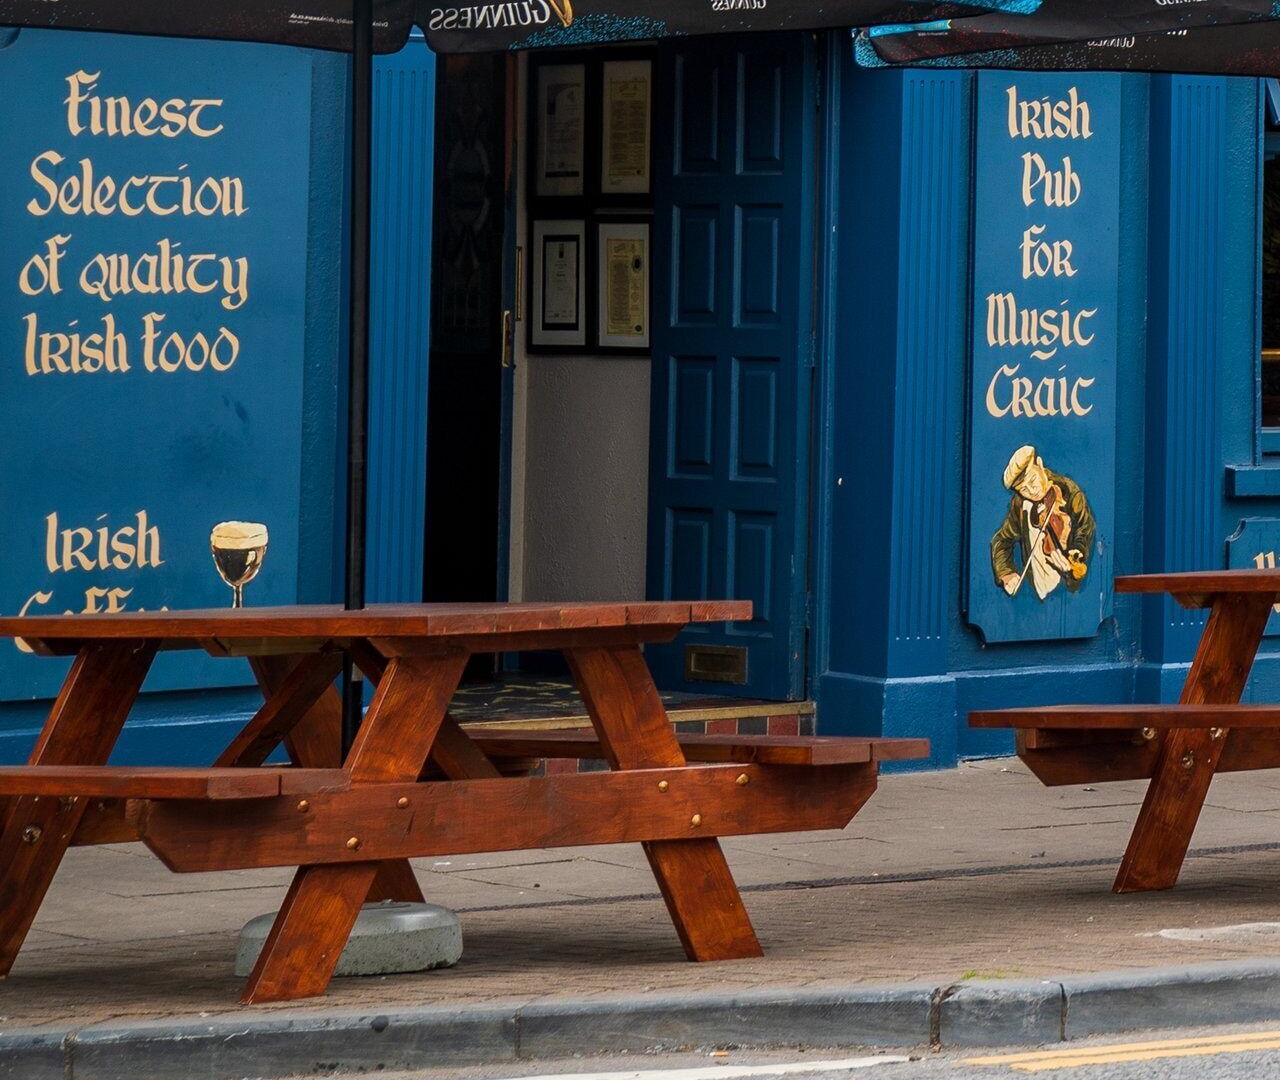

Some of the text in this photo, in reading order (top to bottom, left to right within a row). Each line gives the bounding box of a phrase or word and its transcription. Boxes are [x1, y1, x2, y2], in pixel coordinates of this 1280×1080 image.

[1006, 85, 1093, 140] Irish
[27, 151, 249, 218] Selection
[1022, 152, 1081, 208] Pub
[18, 233, 73, 296] of
[22, 312, 132, 376] Irish
[985, 293, 1098, 360] Music
[985, 364, 1095, 418] Craic
[46, 510, 166, 574] Irish
